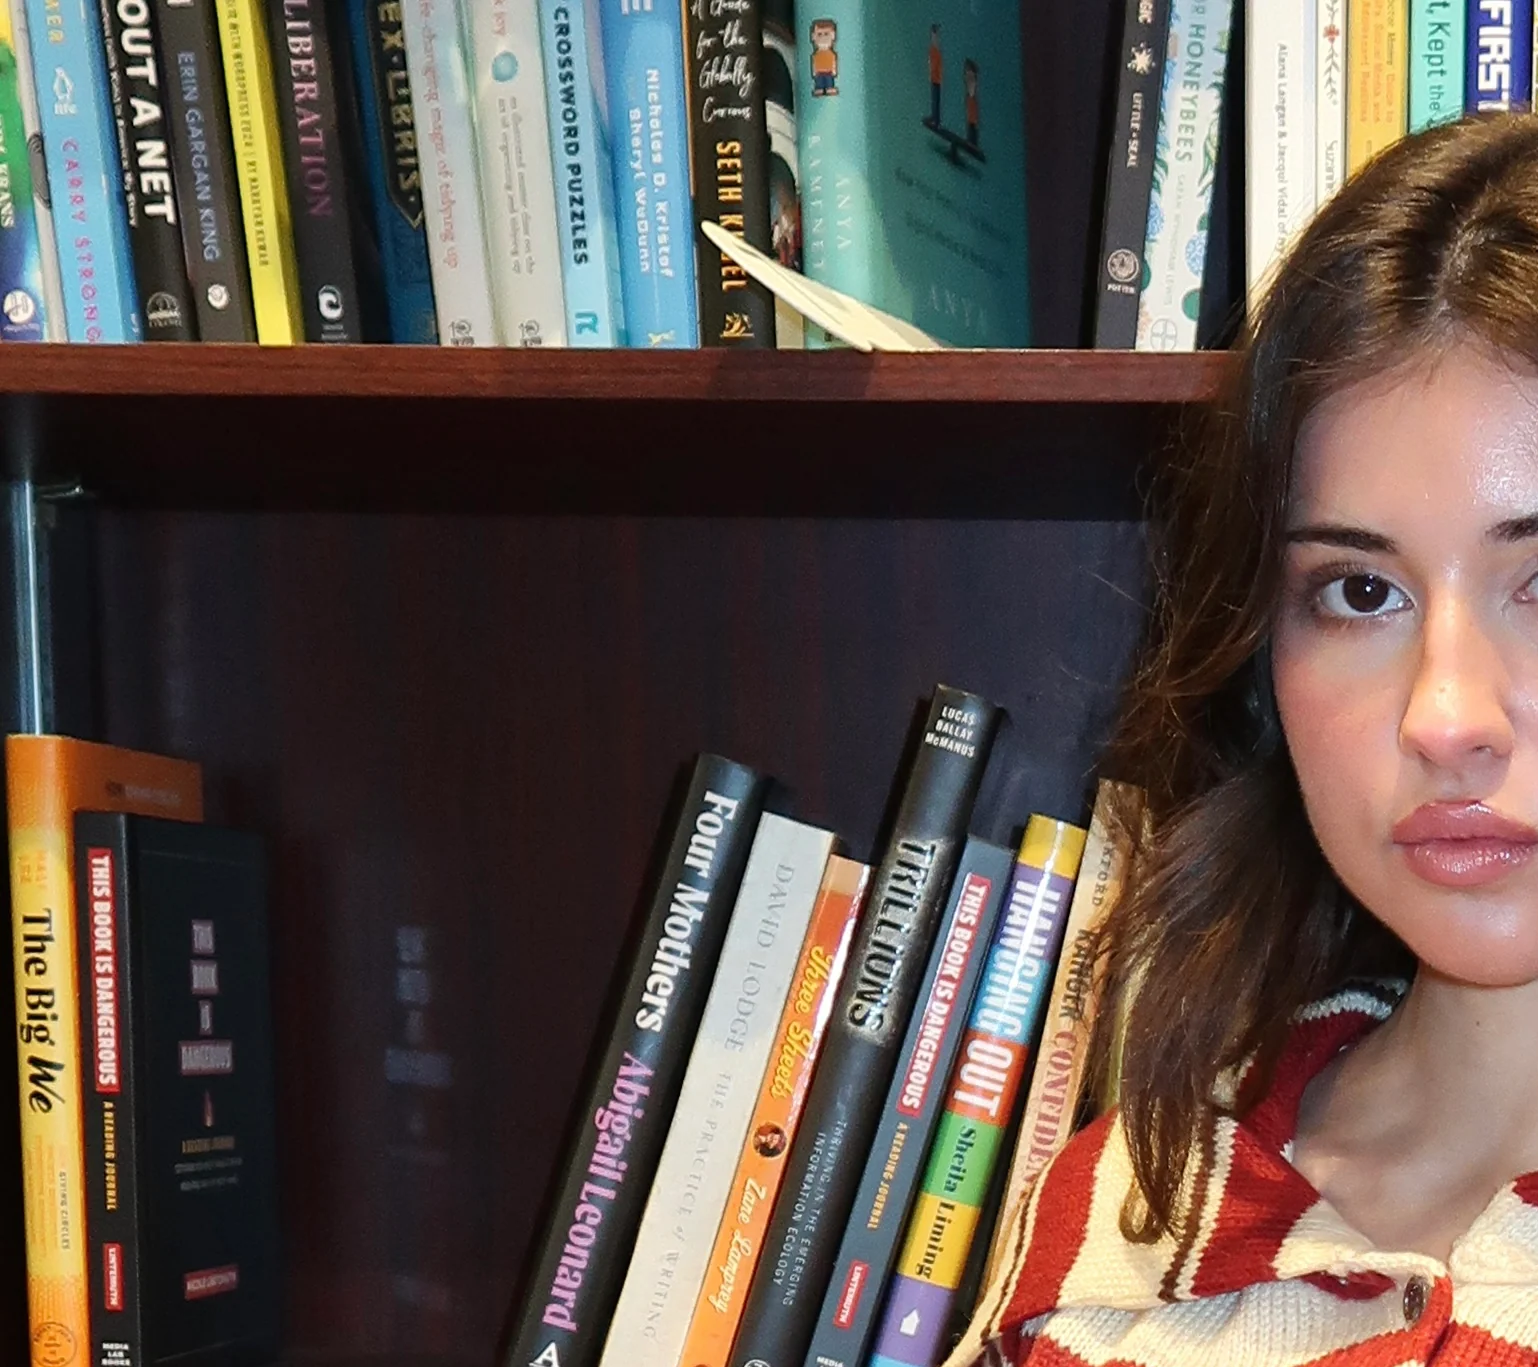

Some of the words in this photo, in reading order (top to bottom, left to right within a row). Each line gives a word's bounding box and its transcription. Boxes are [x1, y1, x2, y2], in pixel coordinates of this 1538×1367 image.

[131, 97, 164, 127] A
[553, 7, 583, 156] CROSSWORD
[136, 140, 177, 226] NET
[628, 108, 646, 181] Sheryl
[647, 68, 663, 166] Nicholas
[656, 199, 675, 278] Kristof
[567, 163, 590, 266] PUZZLES
[925, 733, 975, 759] McMANUS
[941, 705, 976, 725] LUCAS
[684, 790, 740, 878] Four
[90, 855, 111, 897] THIS
[22, 907, 55, 976] The
[93, 899, 111, 953] BOOK
[95, 956, 111, 973] IS
[635, 882, 711, 1033] Mothers
[847, 840, 936, 1034] TRILLIONS
[19, 987, 58, 1045] Big
[96, 975, 118, 1086] DANGEROUS
[28, 1054, 66, 1114] We
[587, 1051, 656, 1185] Abigail
[953, 1037, 1015, 1119] OUT
[943, 1122, 979, 1195] Sheila
[541, 1186, 611, 1333] Leonard
[915, 1200, 956, 1281] Liming
